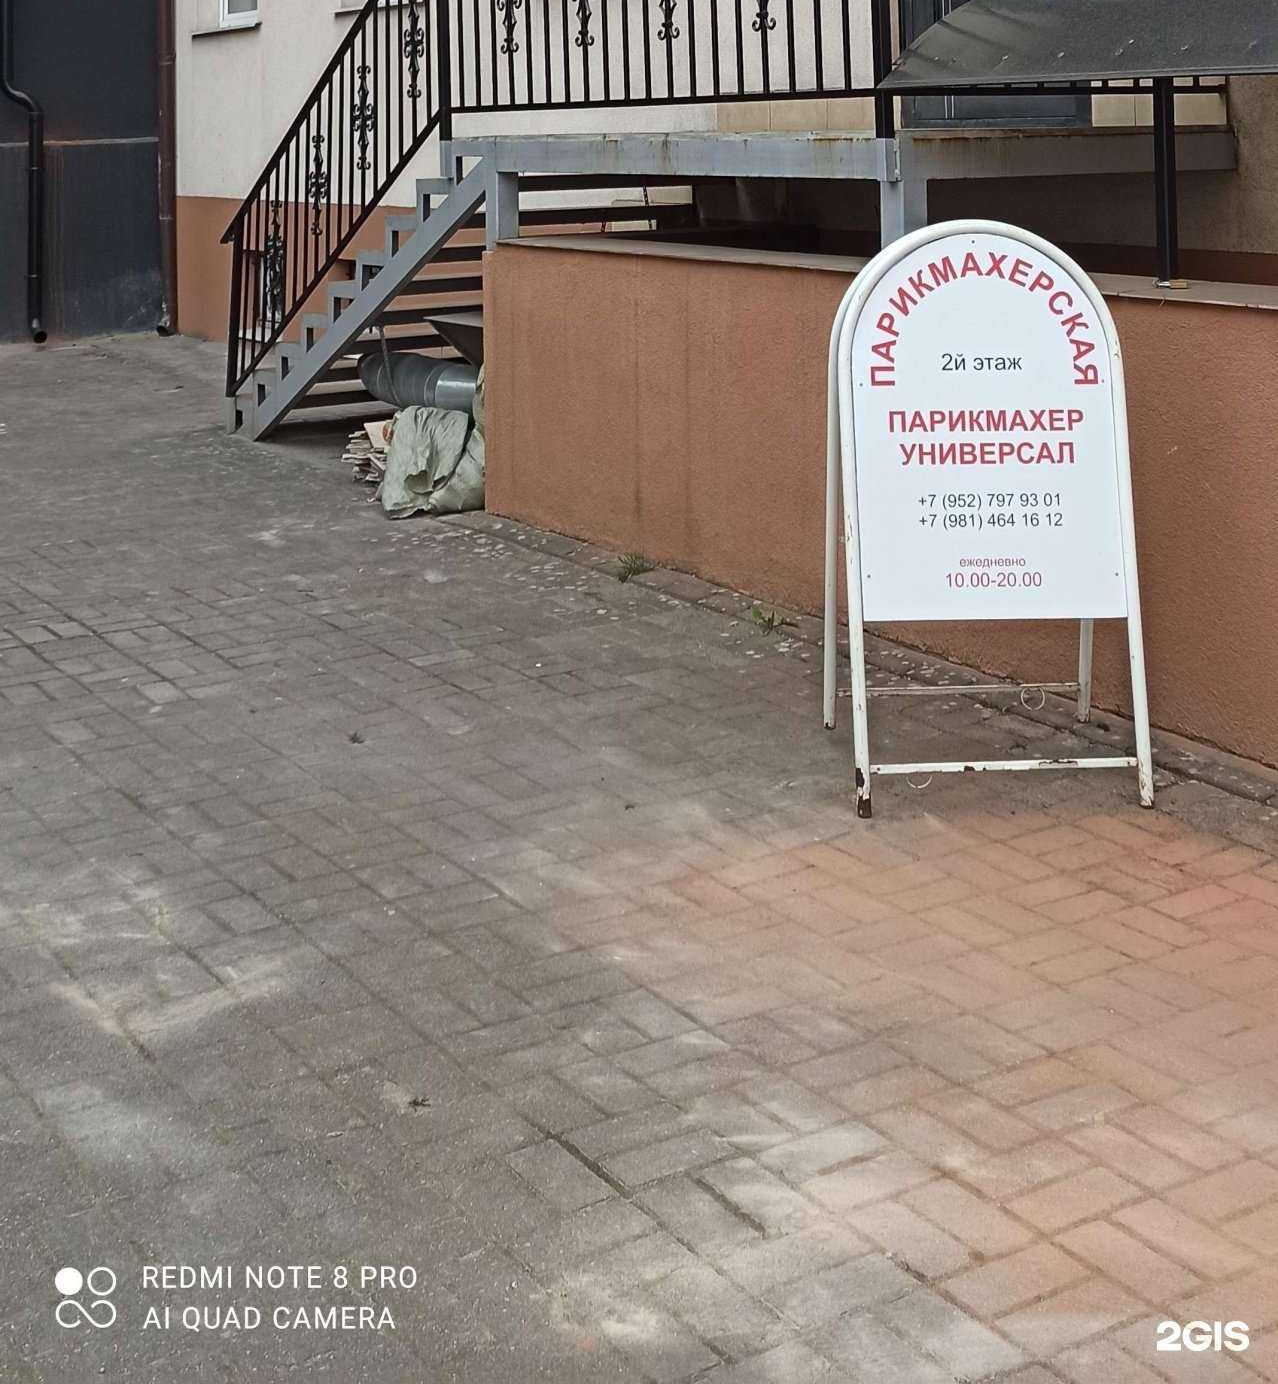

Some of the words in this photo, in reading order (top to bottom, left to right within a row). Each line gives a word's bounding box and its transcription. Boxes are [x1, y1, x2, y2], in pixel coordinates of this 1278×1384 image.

[870, 251, 1099, 387] ПАРИКМАХЕРСКАЯ
[941, 352, 966, 372] 2й
[973, 355, 1023, 372] этаж
[888, 409, 1084, 433] ПАРИКМАХЕР
[900, 441, 1075, 466] УНИВЕРСАЛ
[918, 494, 937, 509] +7
[942, 493, 982, 512] (952)
[986, 493, 1016, 508] 797
[1020, 492, 1039, 508] 93
[1043, 492, 1061, 508] 01
[918, 514, 938, 529] +7
[943, 513, 983, 531] (981)
[987, 512, 1016, 528] 464
[1022, 512, 1040, 528] 16
[1045, 512, 1063, 528] 12
[959, 557, 1026, 569] ежедневно
[945, 572, 1042, 588] 10.00-20.00
